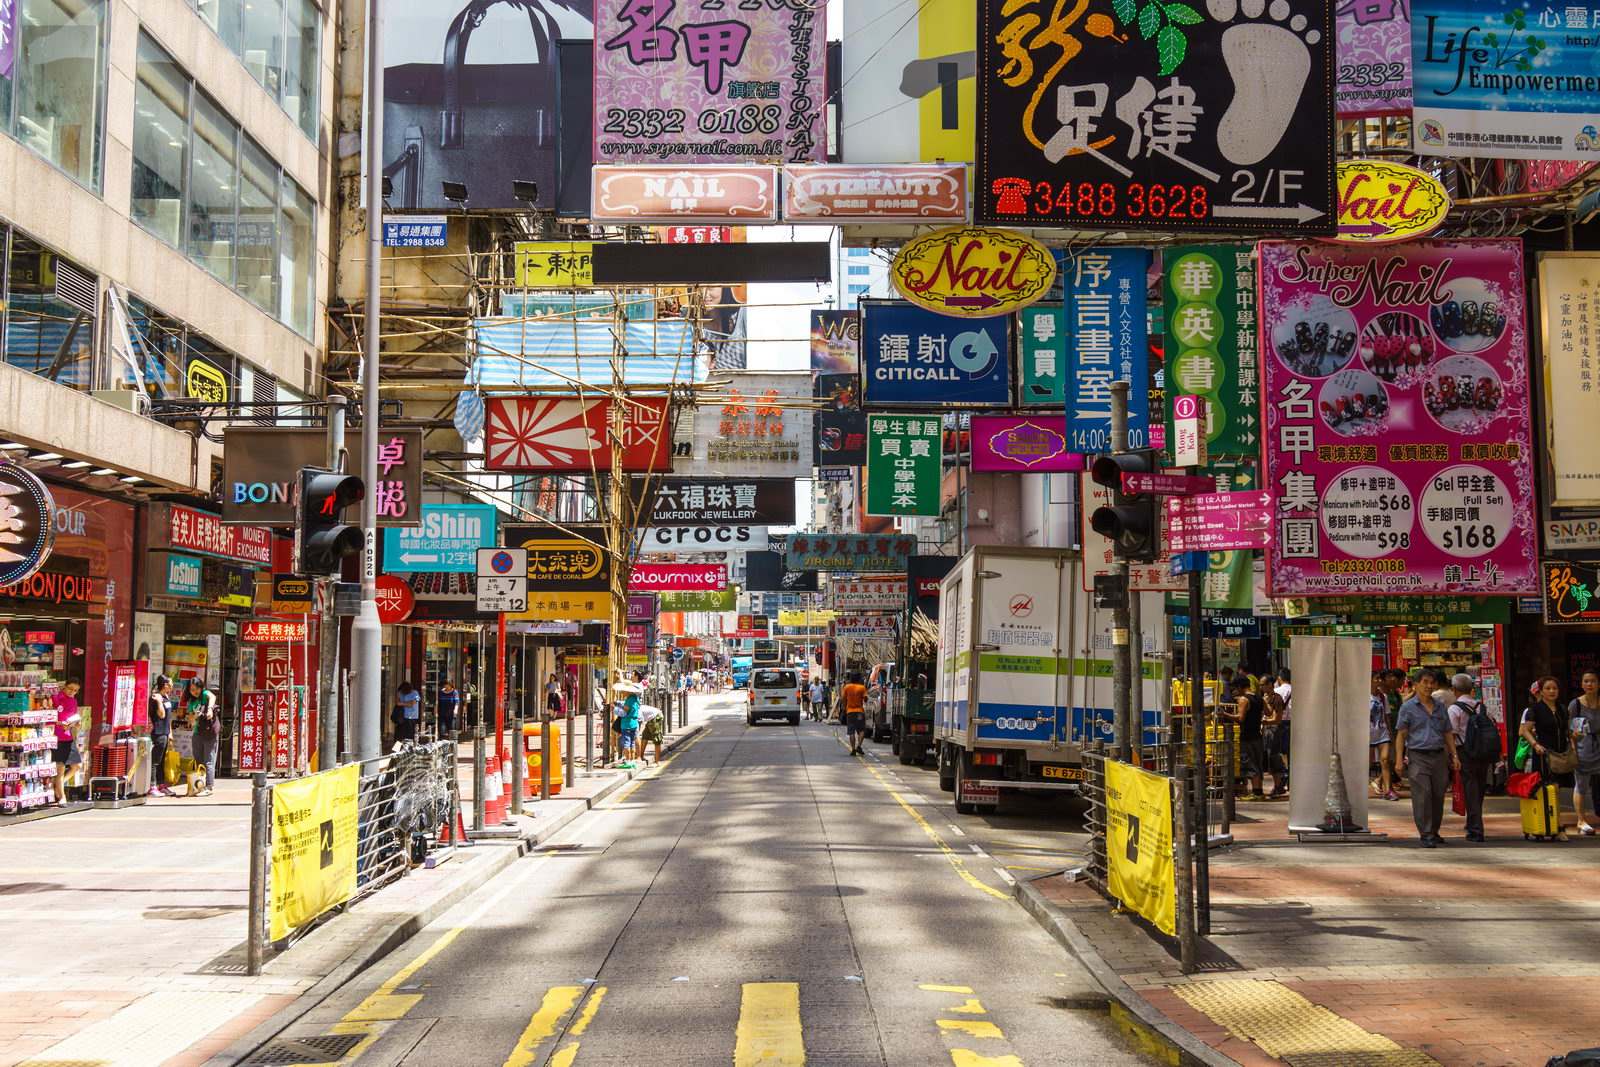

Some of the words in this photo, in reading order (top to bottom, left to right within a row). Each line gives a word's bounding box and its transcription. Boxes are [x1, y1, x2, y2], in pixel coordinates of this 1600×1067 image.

[604, 0, 752, 96] 名甲
[1424, 15, 1489, 97] Life
[1337, 62, 1406, 88] 2332
[1469, 66, 1600, 95] Empowerme
[604, 107, 687, 138] 2332
[696, 104, 782, 135] 0188
[601, 139, 783, 158] www.supernail.com.hk
[643, 177, 726, 199] NAIL
[1230, 168, 1305, 204] 2/F
[1035, 182, 1117, 218] 3488
[1126, 183, 1209, 220] 3628
[386, 238, 401, 247] TEL:
[904, 240, 1031, 294] Nail
[1279, 246, 1364, 291] Super
[1330, 255, 1454, 307] Nail
[1073, 252, 1114, 404] 序言書室
[879, 333, 948, 364] 鐳射
[875, 367, 960, 381] CITICALL
[873, 419, 939, 435] 學生書屋
[880, 438, 932, 457] 買賣
[1177, 429, 1187, 455] Mong
[1188, 432, 1196, 451] Kok
[1278, 378, 1320, 559] 名甲集團
[892, 458, 917, 508] 中學課本
[1434, 477, 1454, 492] Gel
[1457, 475, 1496, 493] 甲全套
[654, 485, 757, 510] 六福珠寶
[1379, 494, 1411, 511] $68
[1463, 495, 1482, 506] (Full
[1486, 495, 1504, 505] Set)
[653, 510, 698, 520] LUKFOOK
[701, 510, 757, 520] JEWELLERY
[242, 526, 265, 544] MONEY
[366, 532, 374, 545] AF
[655, 526, 751, 544] crocs
[1378, 532, 1409, 548] $98
[1443, 525, 1496, 549] $168
[1550, 522, 1600, 538] SNAP
[237, 542, 270, 562] EXCHANGE
[804, 556, 854, 568] VIRGINIA
[169, 560, 199, 585] JoShin
[366, 548, 374, 577] 0526
[485, 583, 501, 591] 上午
[508, 579, 517, 591] 7
[1305, 574, 1422, 586] www.SuperNail.com.hk
[509, 598, 524, 610] 12
[1212, 617, 1256, 626] SUNING
[256, 695, 265, 721] MONEY
[255, 725, 263, 768] EXCHANGE
[1045, 767, 1057, 776] SY
